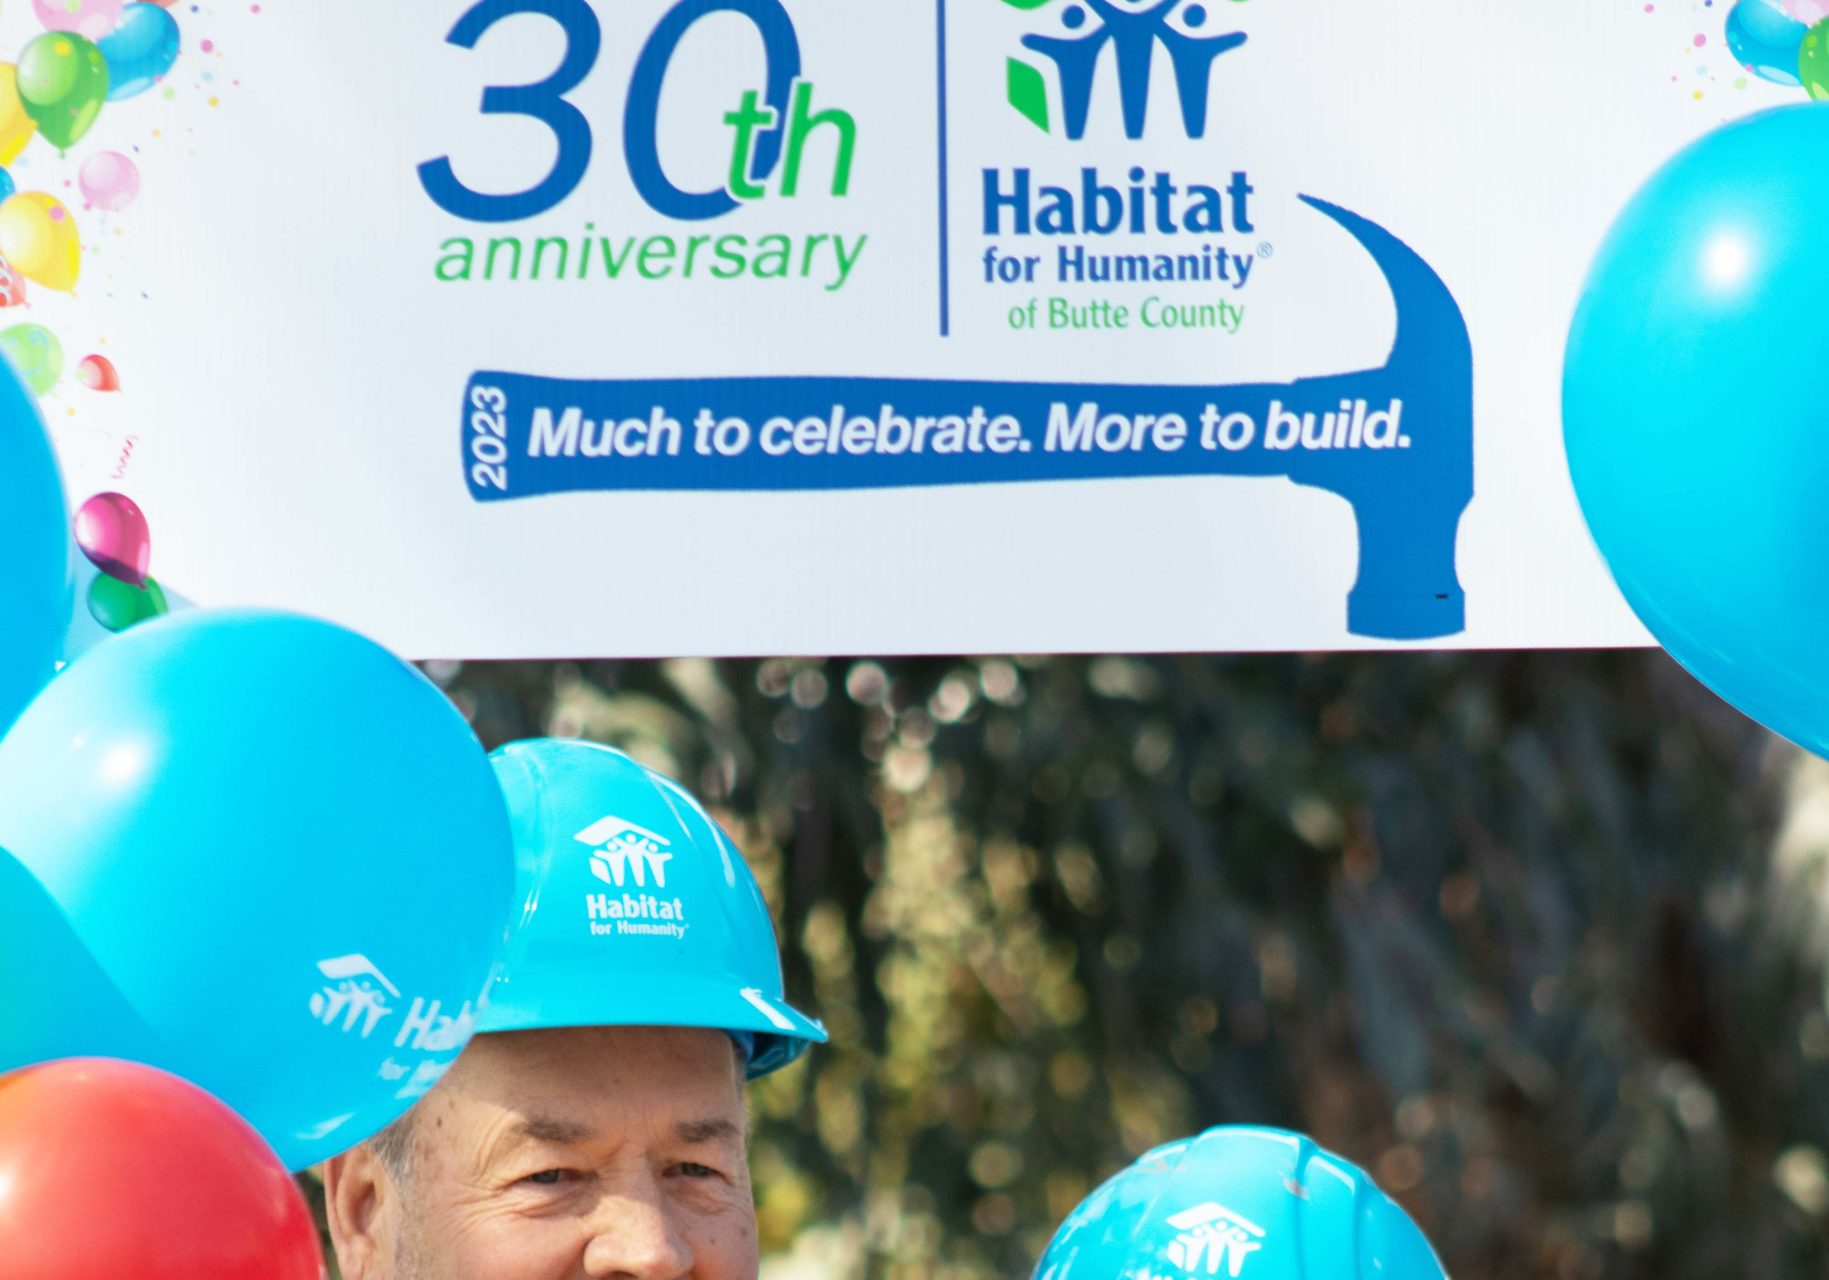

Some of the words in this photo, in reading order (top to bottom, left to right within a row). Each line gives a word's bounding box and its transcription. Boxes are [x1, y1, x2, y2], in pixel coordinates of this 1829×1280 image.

[982, 166, 1254, 236] Habitat
[433, 222, 868, 291] anniversary
[982, 246, 1040, 283] for
[1008, 298, 1037, 329] of
[1048, 297, 1129, 329] Butte
[1140, 296, 1246, 334] County
[471, 385, 507, 490] 2023
[527, 406, 682, 457] Much
[692, 409, 750, 456] to
[759, 404, 1032, 456] celebrate.
[1043, 402, 1187, 453] More
[1199, 404, 1256, 451] to
[1264, 398, 1411, 450] build.
[586, 893, 684, 920] Habitat
[590, 921, 612, 936] for
